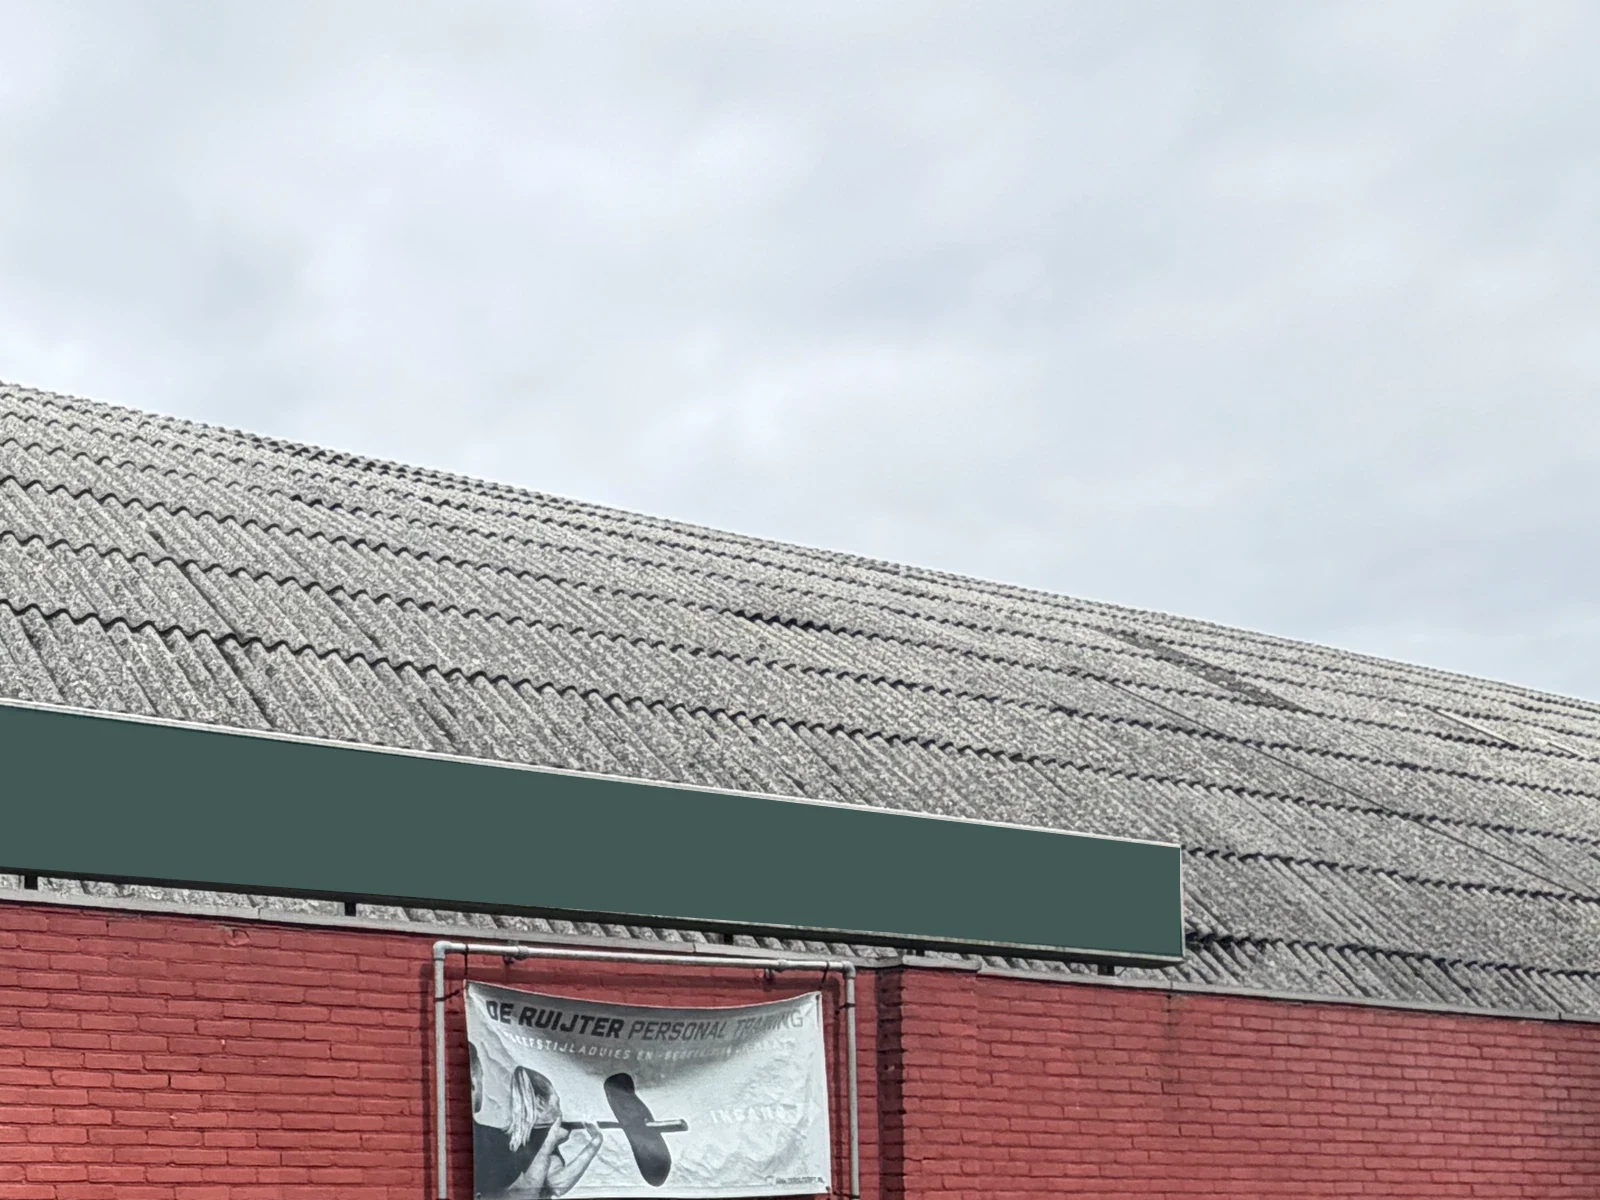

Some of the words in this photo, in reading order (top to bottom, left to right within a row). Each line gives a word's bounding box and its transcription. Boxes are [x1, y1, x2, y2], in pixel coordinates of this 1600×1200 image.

[486, 1000, 514, 1024] DE
[518, 1006, 625, 1039] RUIJTER
[628, 1019, 728, 1042] PERSONAL
